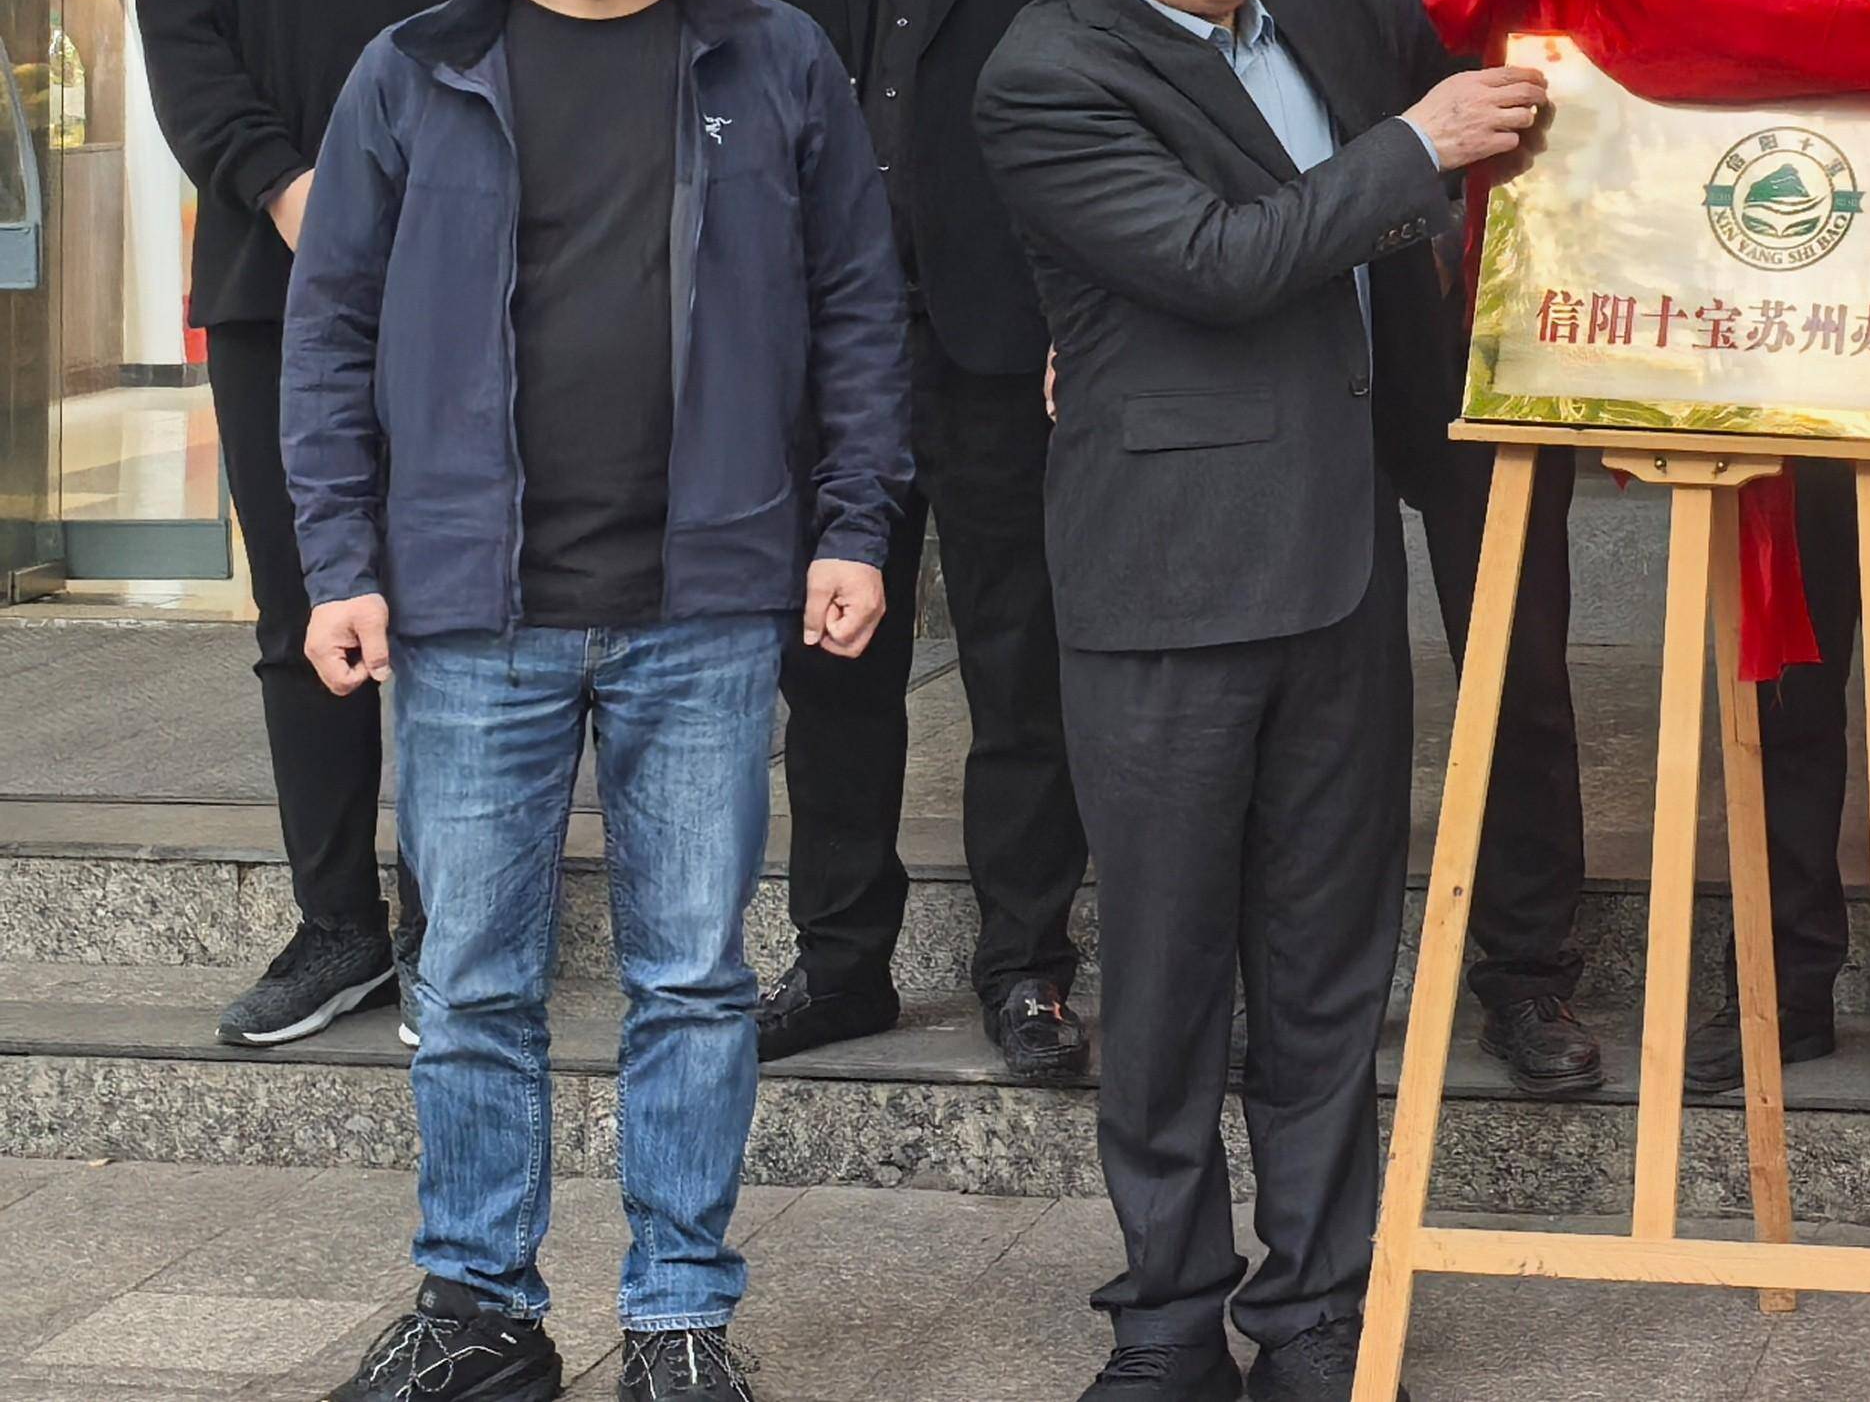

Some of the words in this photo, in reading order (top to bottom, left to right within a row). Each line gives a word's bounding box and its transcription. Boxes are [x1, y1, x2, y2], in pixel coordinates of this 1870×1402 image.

[1737, 240, 1784, 265] YANG
[1788, 246, 1815, 265] SHI
[1816, 213, 1848, 251] BAO
